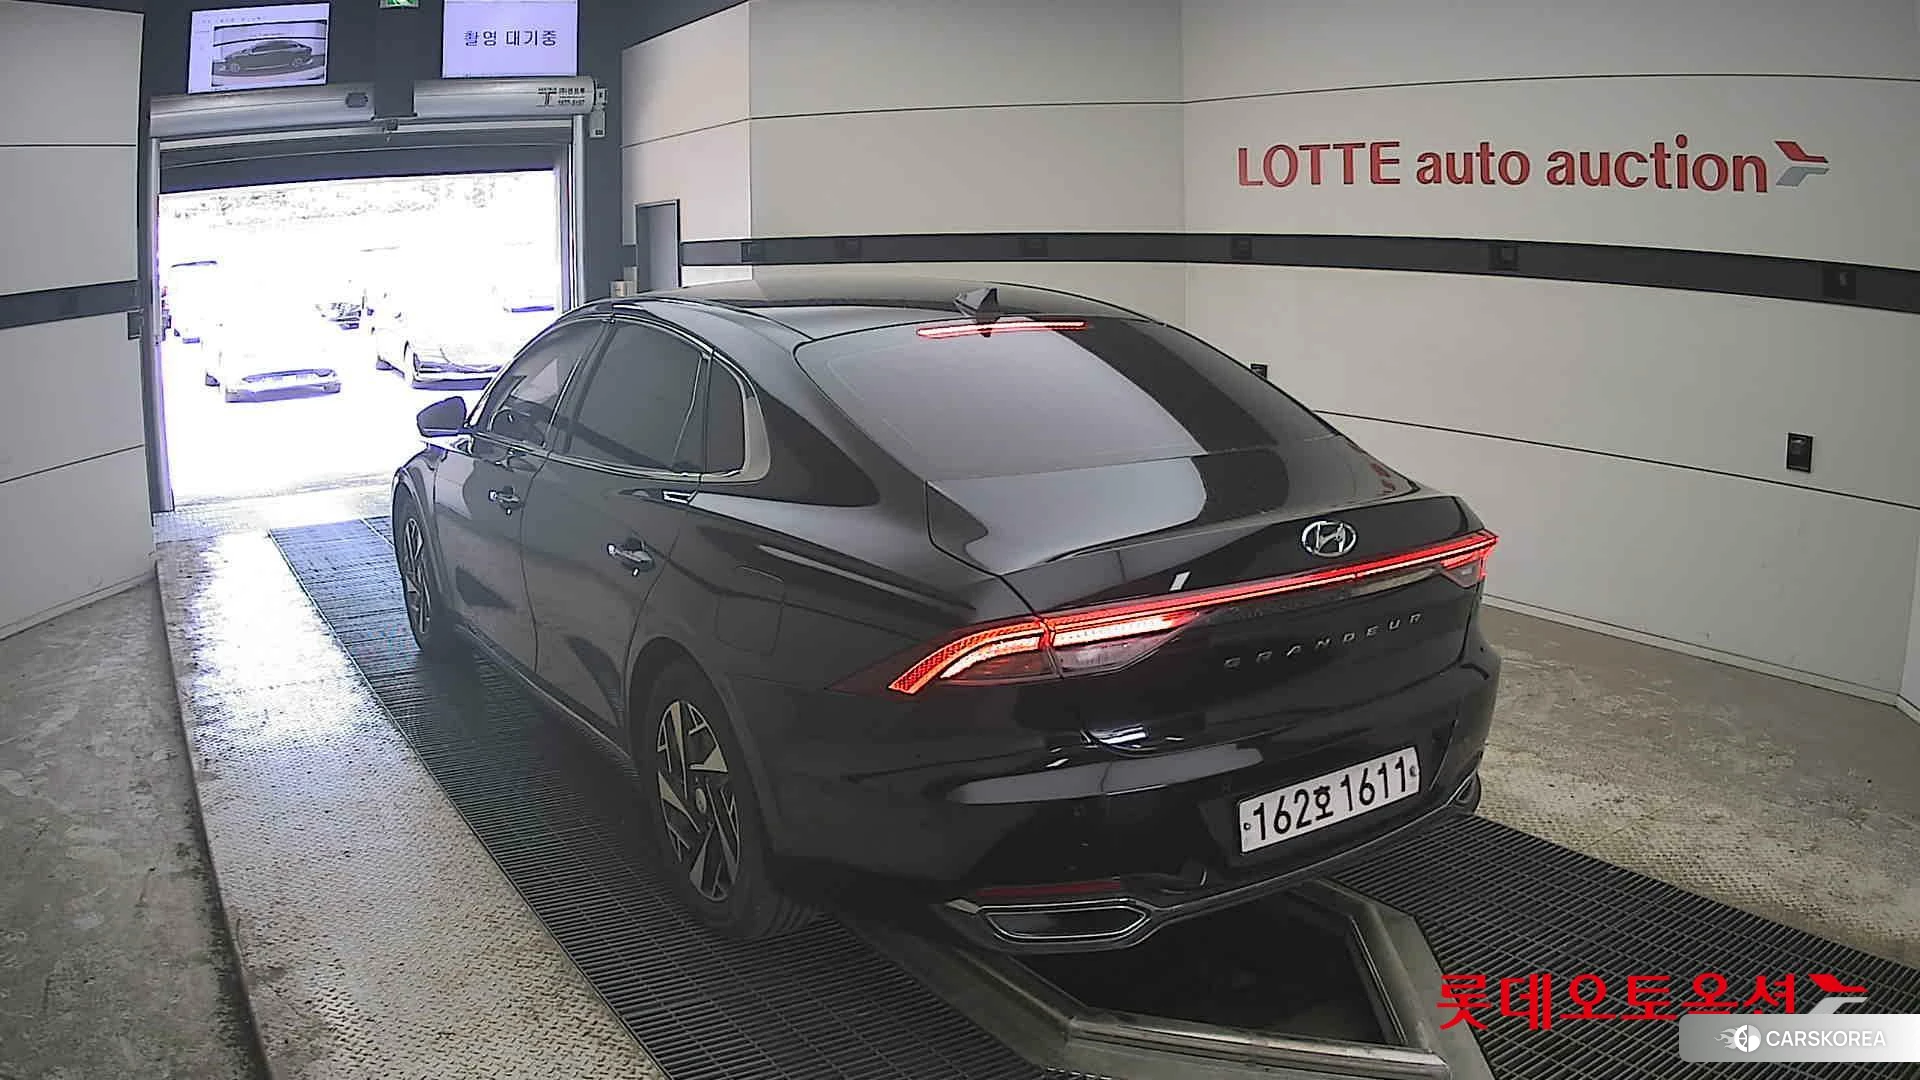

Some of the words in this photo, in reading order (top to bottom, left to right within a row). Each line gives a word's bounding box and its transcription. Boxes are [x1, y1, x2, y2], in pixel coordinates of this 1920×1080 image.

[506, 30, 557, 47] 대기중
[1238, 141, 1400, 187] LOTTE
[1416, 142, 1530, 185] auto
[1546, 134, 1768, 193] auction
[1224, 613, 1421, 668] GRANDEUR
